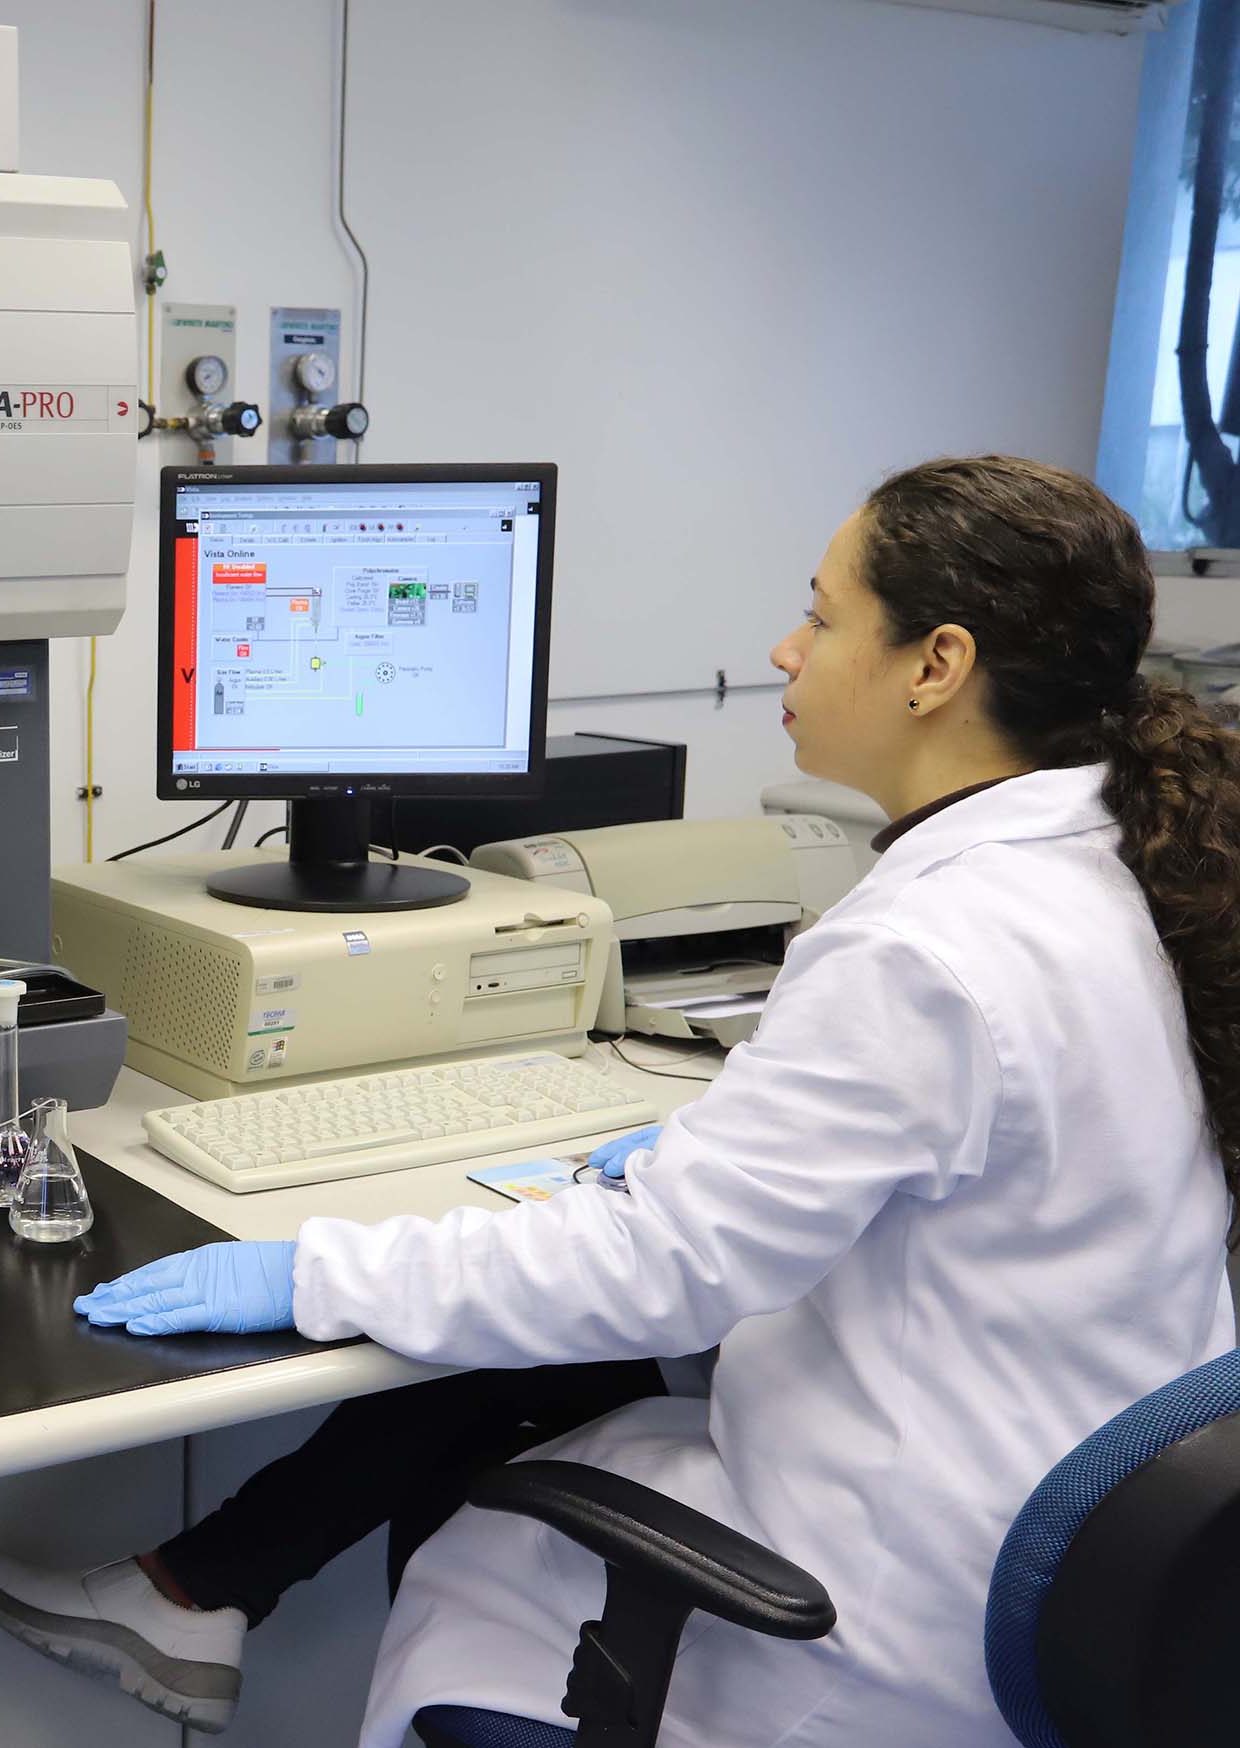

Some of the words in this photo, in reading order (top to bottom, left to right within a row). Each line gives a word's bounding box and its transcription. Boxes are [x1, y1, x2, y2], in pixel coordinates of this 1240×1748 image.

[204, 550, 225, 558] Vista
[227, 550, 255, 558] Online
[181, 668, 195, 684] V
[189, 780, 201, 789] LG
